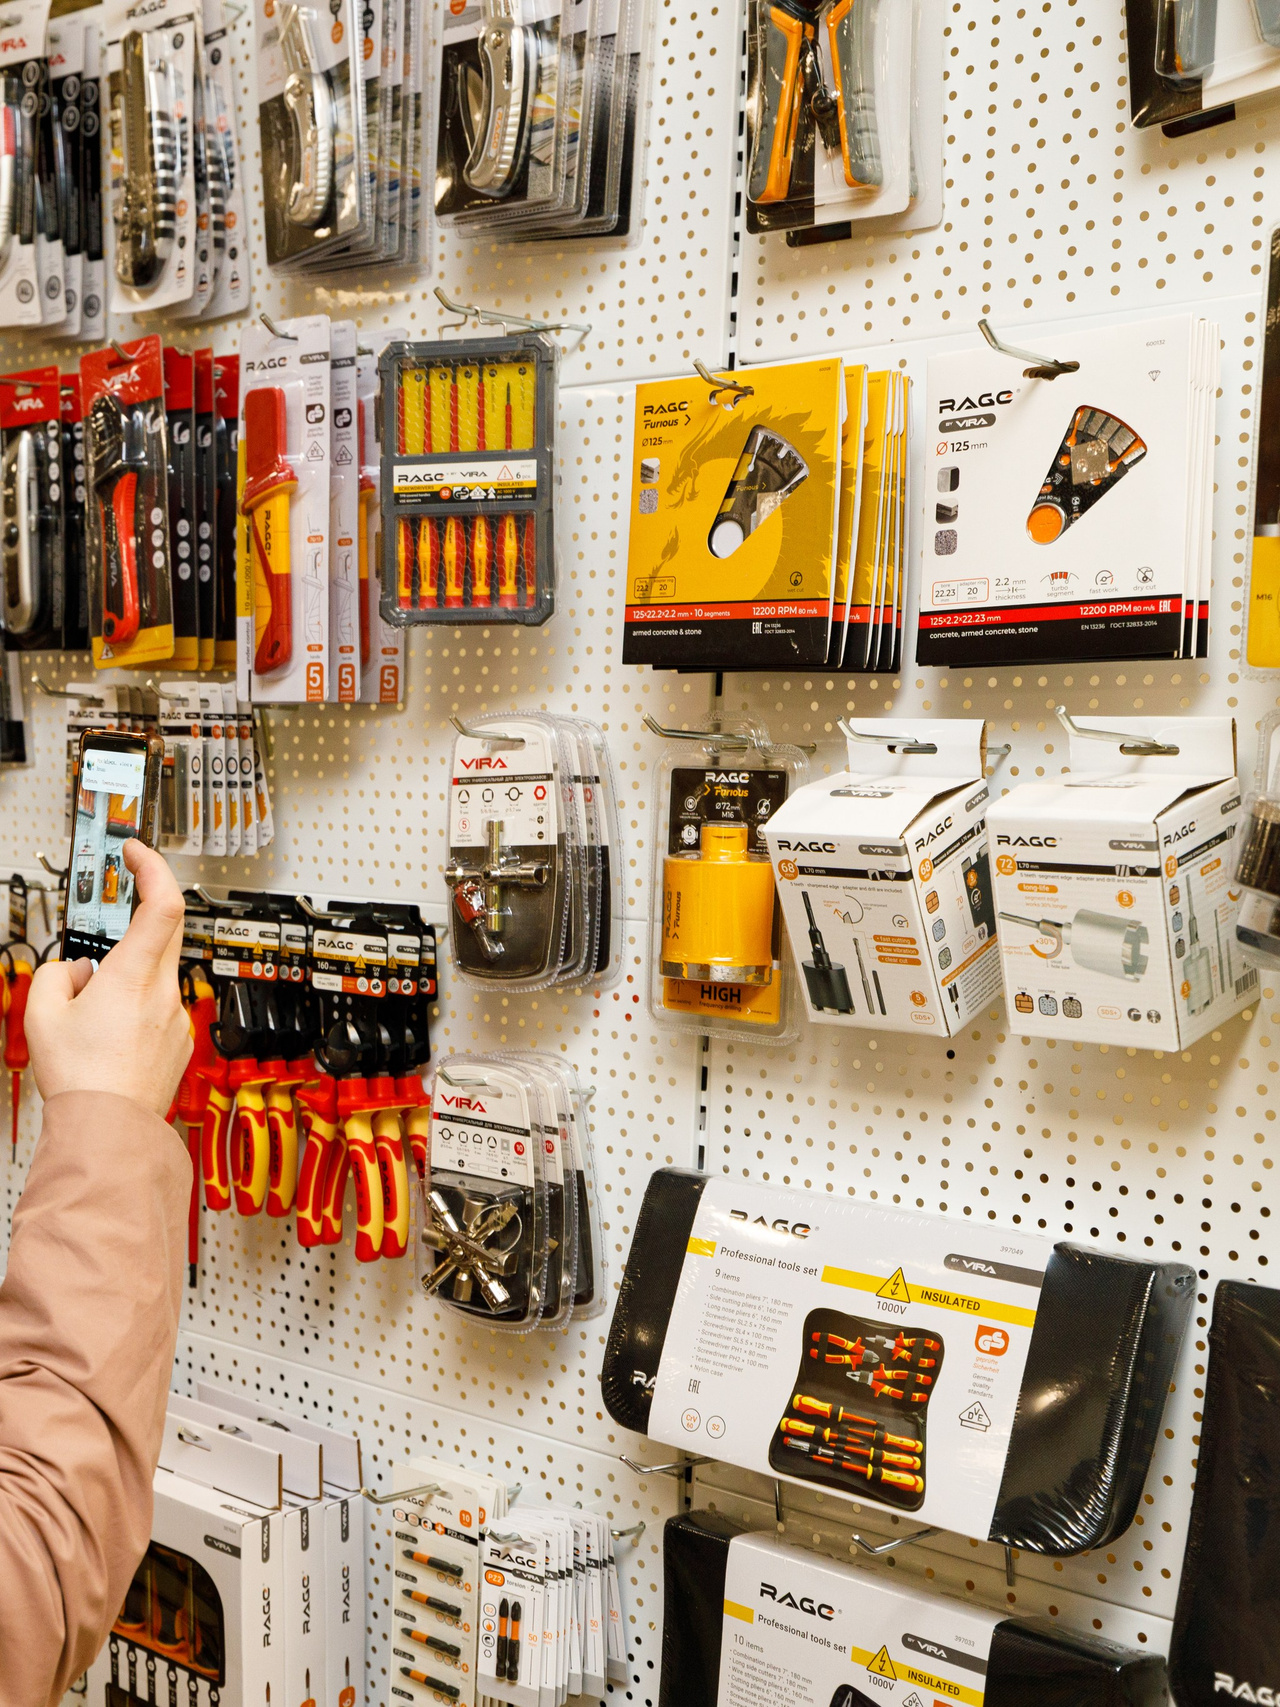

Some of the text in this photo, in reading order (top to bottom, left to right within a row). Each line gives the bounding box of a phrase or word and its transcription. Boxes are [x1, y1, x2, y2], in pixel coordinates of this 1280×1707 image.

[102, 371, 140, 388] VIRA
[13, 398, 44, 411] VIRA
[939, 390, 1013, 414] RAGE
[644, 419, 679, 429] Furious
[955, 417, 988, 427] VIRA
[951, 441, 969, 452] 125
[995, 578, 1009, 586] 2.2
[935, 589, 956, 598] 22.23
[967, 587, 978, 595] 20
[752, 606, 776, 615] 12200
[778, 606, 797, 614] RPM
[1080, 606, 1107, 615] 12200
[1109, 604, 1131, 613] RPM
[1143, 604, 1155, 612] m/s
[633, 629, 651, 637] armed
[930, 631, 960, 639] concrete,
[961, 629, 983, 637] armed
[309, 666, 320, 687] 5
[341, 667, 352, 688] 5
[383, 669, 395, 689] 5
[460, 757, 507, 770] VIRA
[777, 840, 836, 853] RAGE
[997, 835, 1057, 848] RAGE
[870, 846, 894, 854] VIRA
[781, 862, 794, 873] 68
[920, 860, 931, 876] 68
[999, 858, 1013, 869] 72
[892, 937, 910, 945] cutting
[894, 947, 916, 955] vibration
[317, 962, 329, 970] 160
[701, 984, 741, 1003] HIGH
[699, 1001, 723, 1009] frequency
[724, 1003, 742, 1012] drilling
[440, 1094, 487, 1113] VIRA
[1000, 1245, 1024, 1256] 397049
[720, 1246, 818, 1276] Professional tools set
[962, 1259, 997, 1275] VIRA
[715, 1269, 740, 1282] 9 items
[712, 1285, 745, 1297] Combination
[722, 1297, 740, 1306] cutting
[920, 1289, 981, 1312] INSULATED
[876, 1301, 907, 1315] 1000V
[705, 1311, 736, 1324] Screwdriver
[703, 1320, 734, 1332] Screwdriver
[701, 1329, 732, 1341] Screwdriver
[699, 1338, 730, 1350] Screwdriver
[697, 1346, 728, 1359] Screwdriver
[696, 1355, 743, 1372] Tester screwdriver
[975, 1356, 998, 1365] geprüfte
[694, 1365, 723, 1377] Nylon case
[972, 1362, 999, 1374] Sicherheit
[972, 1373, 994, 1383] German
[972, 1381, 991, 1391] quality
[968, 1388, 994, 1399] standarts
[488, 1574, 502, 1583] PZ2
[506, 1580, 526, 1589] torsion
[760, 1582, 835, 1621] RAGE
[610, 1610, 618, 1618] 50
[590, 1620, 598, 1628] 50
[528, 1634, 538, 1642] 50
[543, 1632, 552, 1640] 50
[758, 1614, 846, 1654] Professional tools set
[734, 1633, 764, 1653] 10 items
[954, 1635, 975, 1647] 397033
[917, 1640, 947, 1658] VIRA
[733, 1649, 765, 1666] Combination
[868, 1675, 895, 1691] 1000V
[908, 1670, 960, 1695] INSULATED
[1214, 1672, 1280, 1707] RAG
